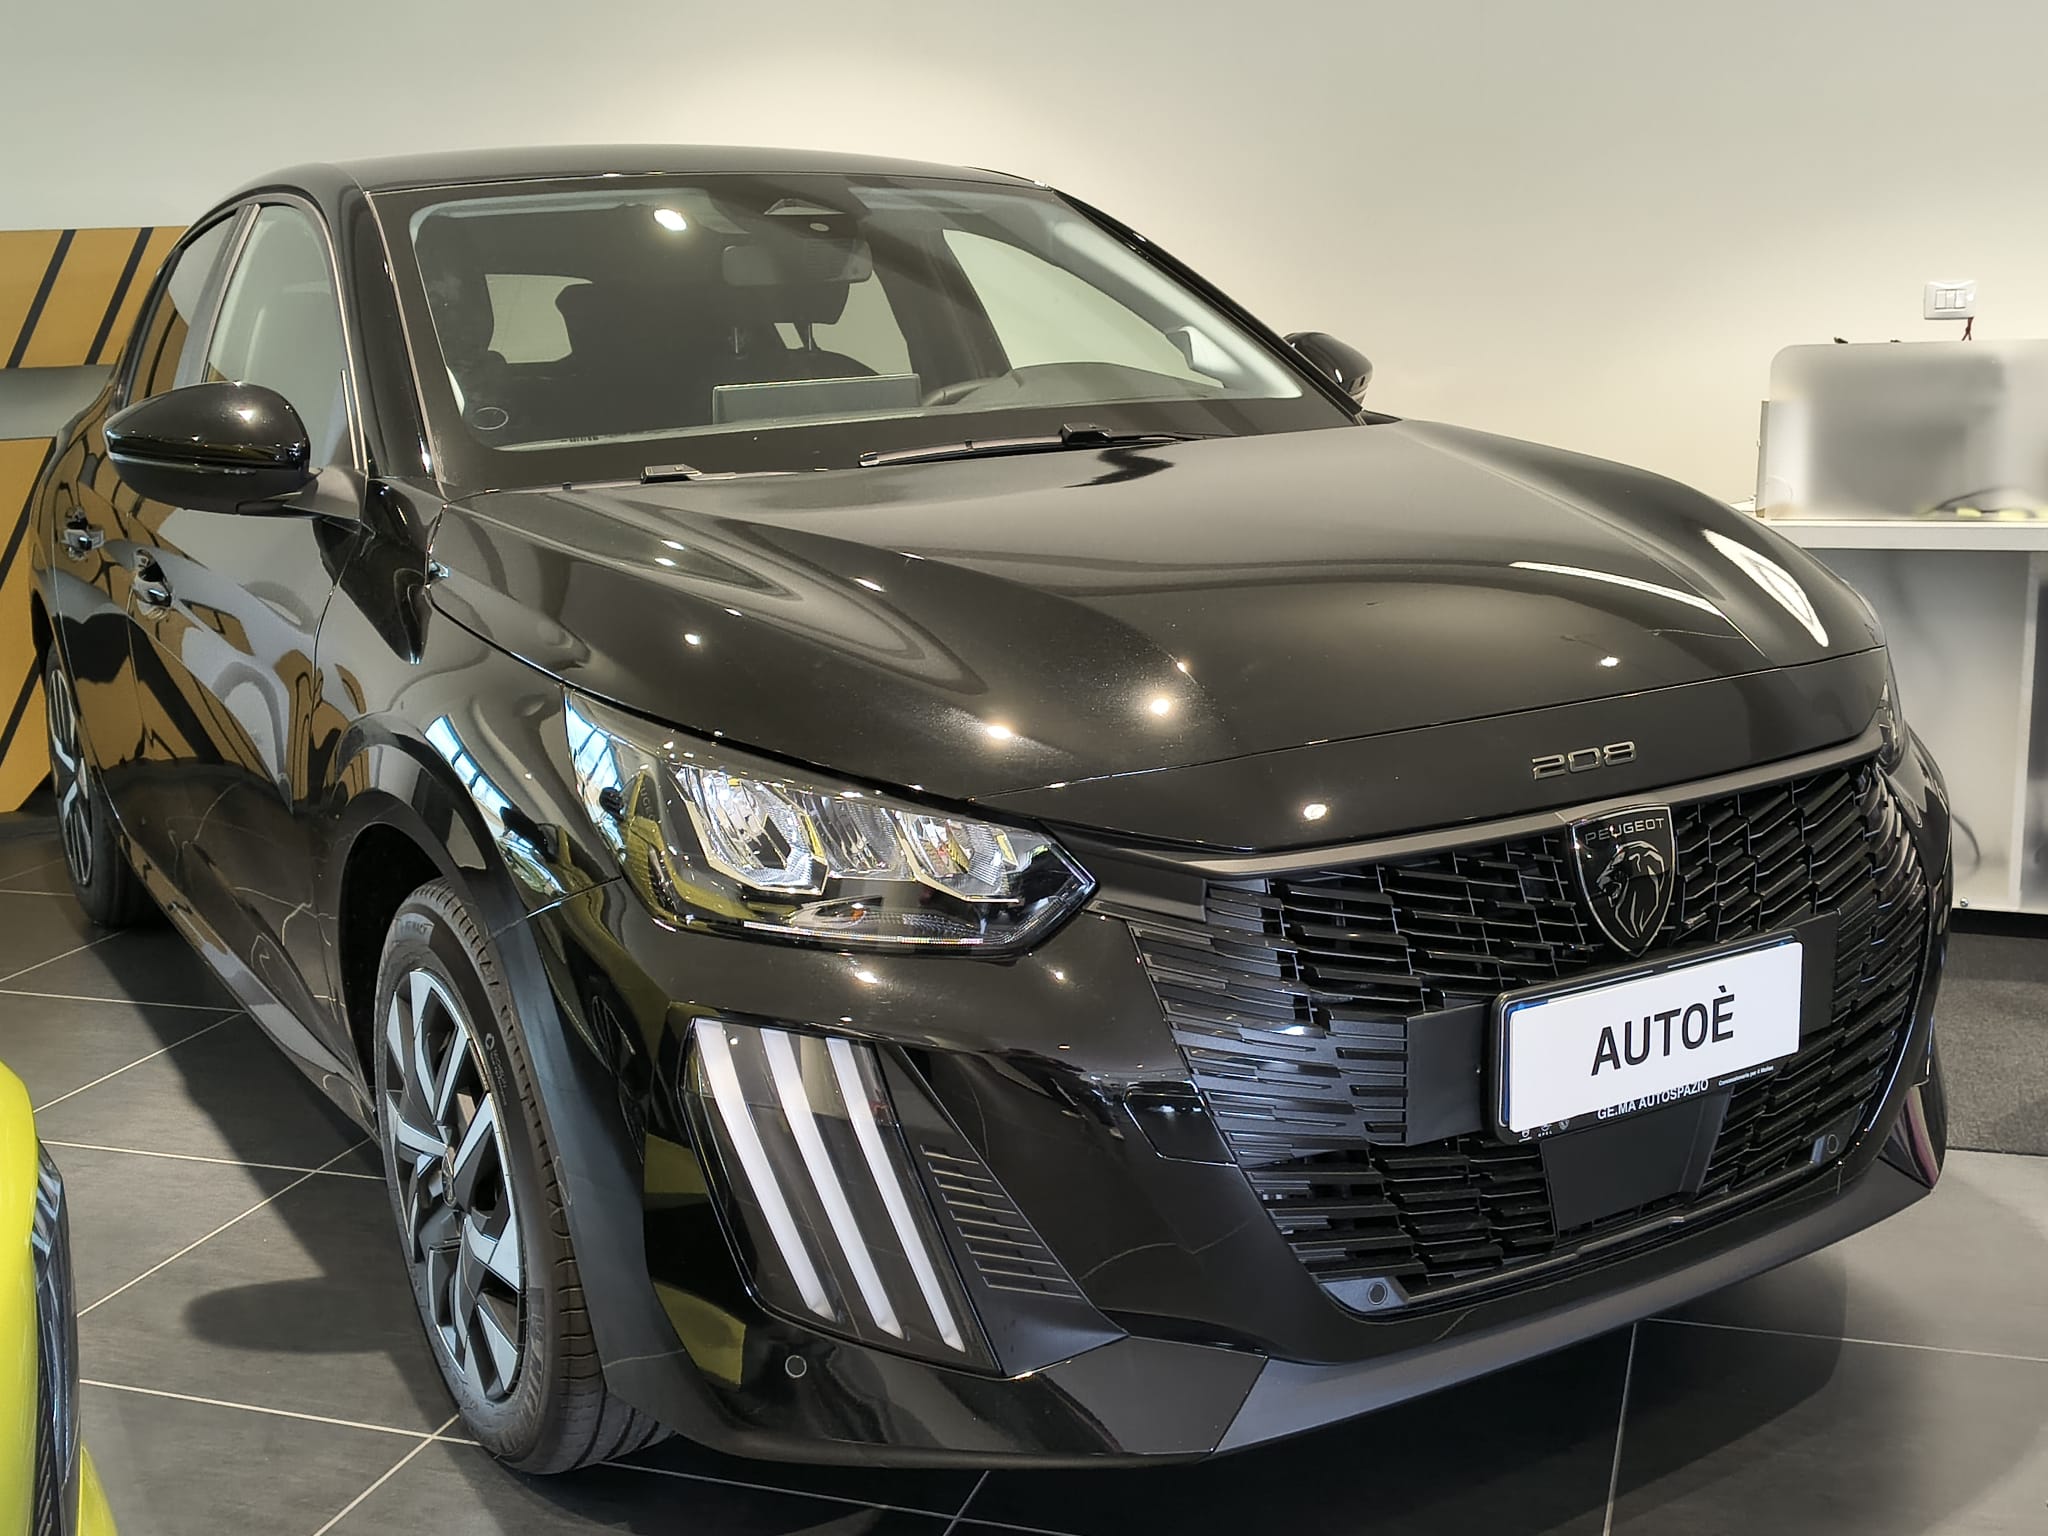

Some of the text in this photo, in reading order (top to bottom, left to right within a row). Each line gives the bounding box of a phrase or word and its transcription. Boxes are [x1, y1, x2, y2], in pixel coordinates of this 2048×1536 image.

[1531, 741, 1636, 780] 208
[1585, 818, 1665, 845] PEUGEOT
[1591, 985, 1735, 1076] AUTOÈ
[1597, 1079, 1709, 1120] GE.MA AUTOSPAZIO
